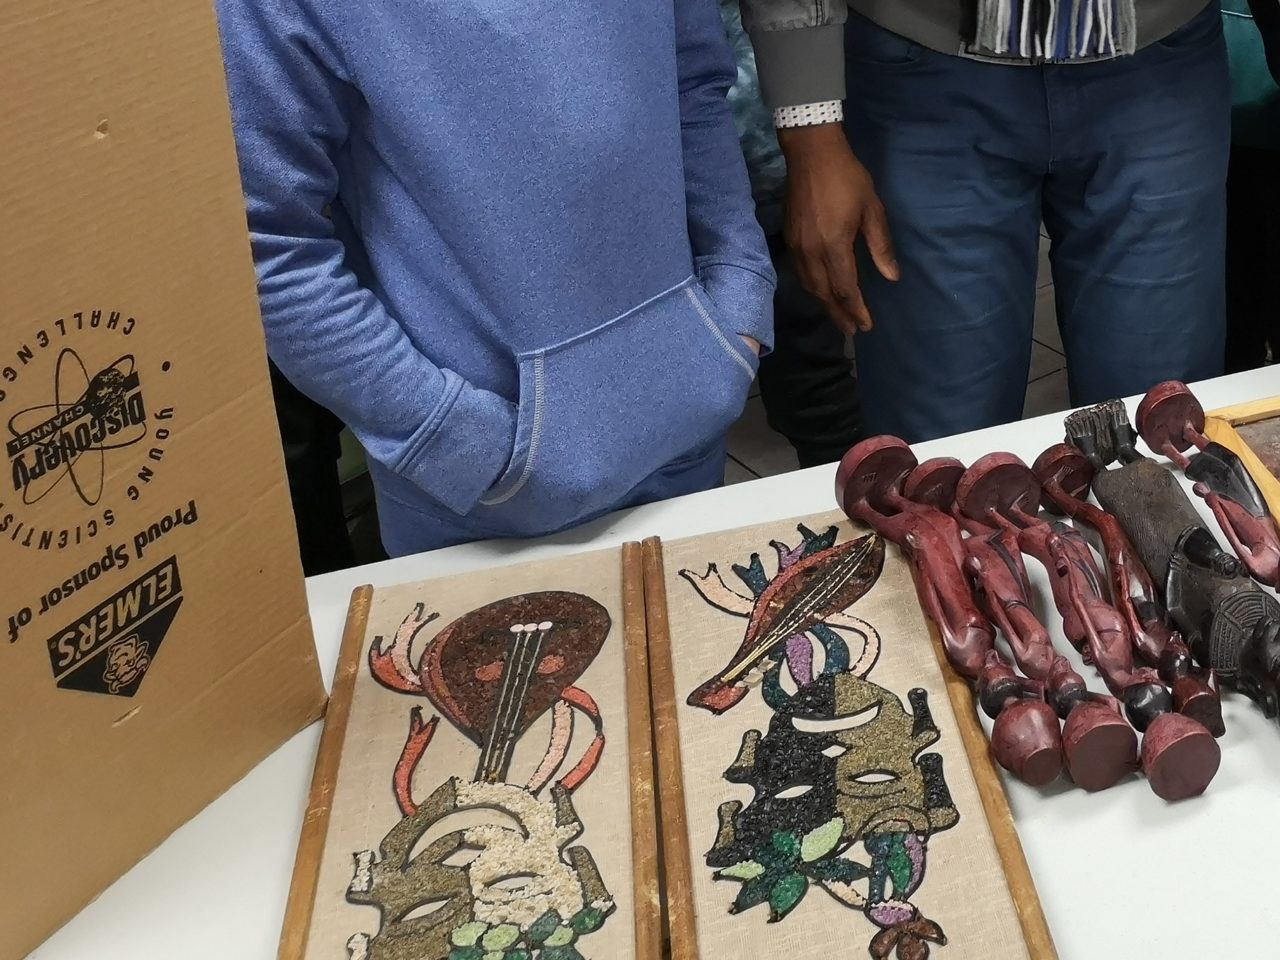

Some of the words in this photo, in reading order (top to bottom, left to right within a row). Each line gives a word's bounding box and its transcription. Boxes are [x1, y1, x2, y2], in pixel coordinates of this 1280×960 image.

[12, 405, 85, 451] CHANNEL
[0, 502, 115, 551] SCIENTIS
[133, 499, 198, 560] Proud
[38, 542, 130, 616] Sponsor
[8, 606, 33, 644] of
[58, 563, 173, 668] ELMER'S
